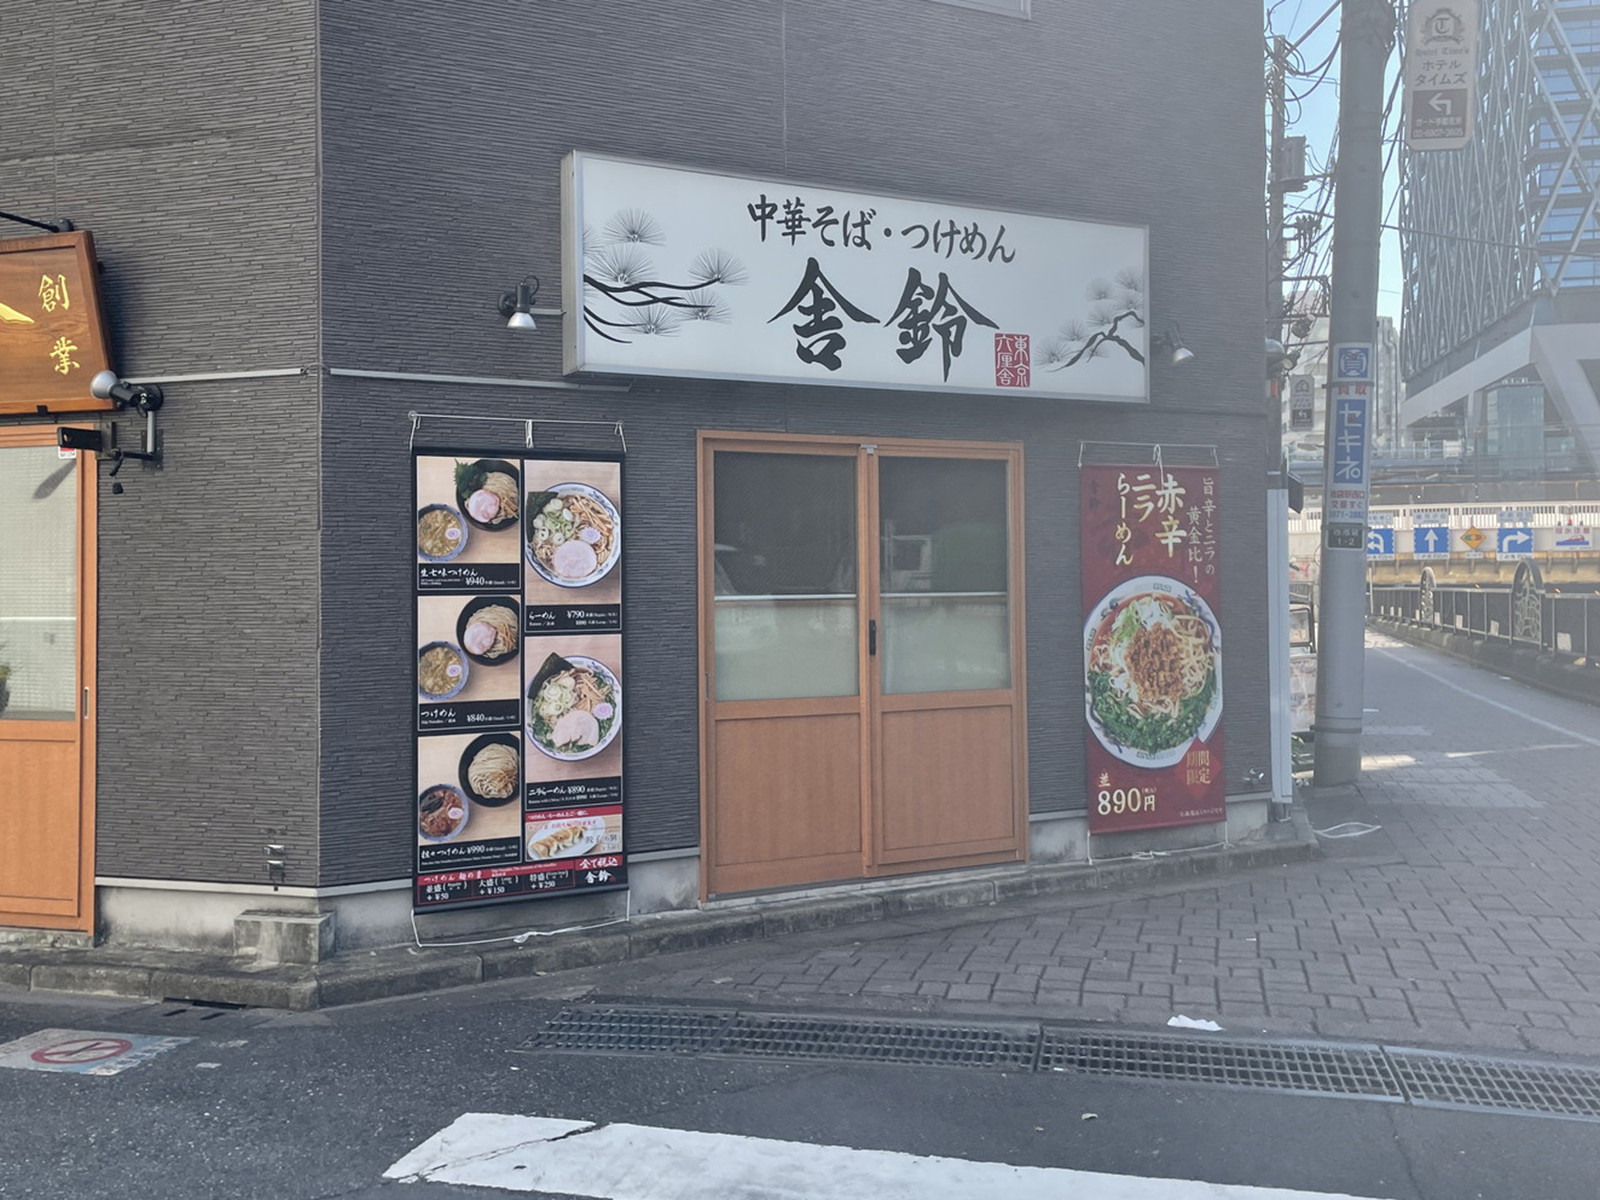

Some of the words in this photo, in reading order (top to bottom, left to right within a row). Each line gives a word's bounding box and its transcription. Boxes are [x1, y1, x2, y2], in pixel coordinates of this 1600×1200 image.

[1422, 59, 1462, 71] ホテル
[1414, 71, 1468, 87] タイムズ
[747, 193, 1016, 264] 中華そば・つけめん
[38, 273, 81, 376] 創業
[996, 334, 1013, 387] 六厘舎
[1013, 335, 1030, 388] 東京
[1131, 473, 1157, 523] ニラ
[1114, 472, 1134, 566] らーめん
[1154, 473, 1187, 558] 赤辛
[1201, 476, 1217, 576] 旨辛とニラの
[1337, 538, 1355, 546] 1-2
[465, 576, 485, 586] ¥940
[529, 611, 556, 620] らーめん
[567, 609, 585, 619] ¥790
[420, 708, 456, 719] つけめん
[466, 713, 485, 723] ¥840
[567, 784, 585, 794] ¥890
[466, 844, 485, 854] ¥990
[579, 857, 619, 870] 全て税込
